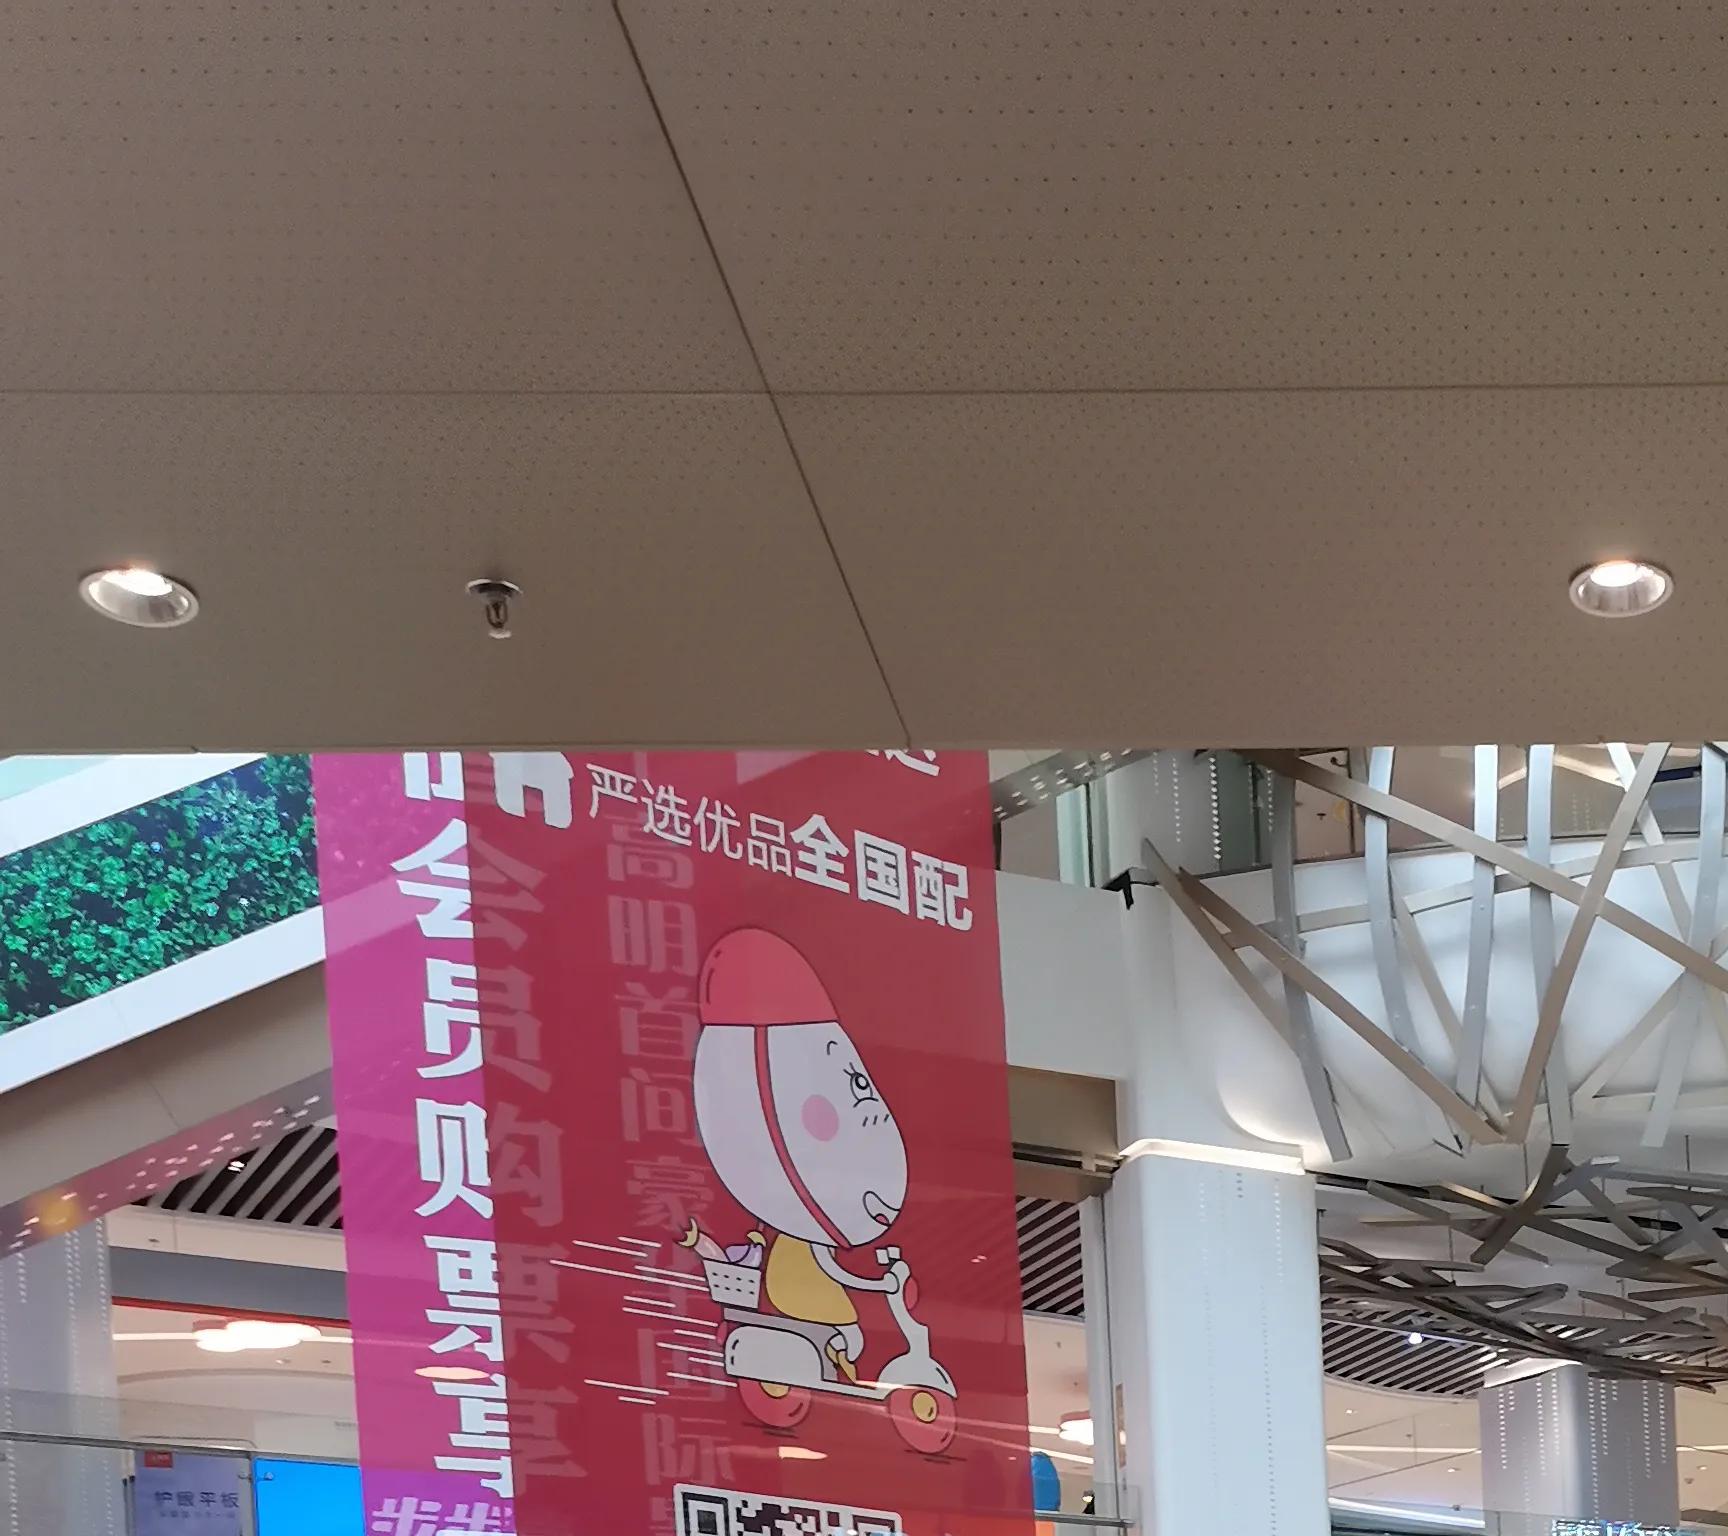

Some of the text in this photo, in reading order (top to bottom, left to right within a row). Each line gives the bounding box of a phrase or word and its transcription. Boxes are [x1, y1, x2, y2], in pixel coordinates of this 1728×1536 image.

[587, 762, 974, 931] 严选优品全国配
